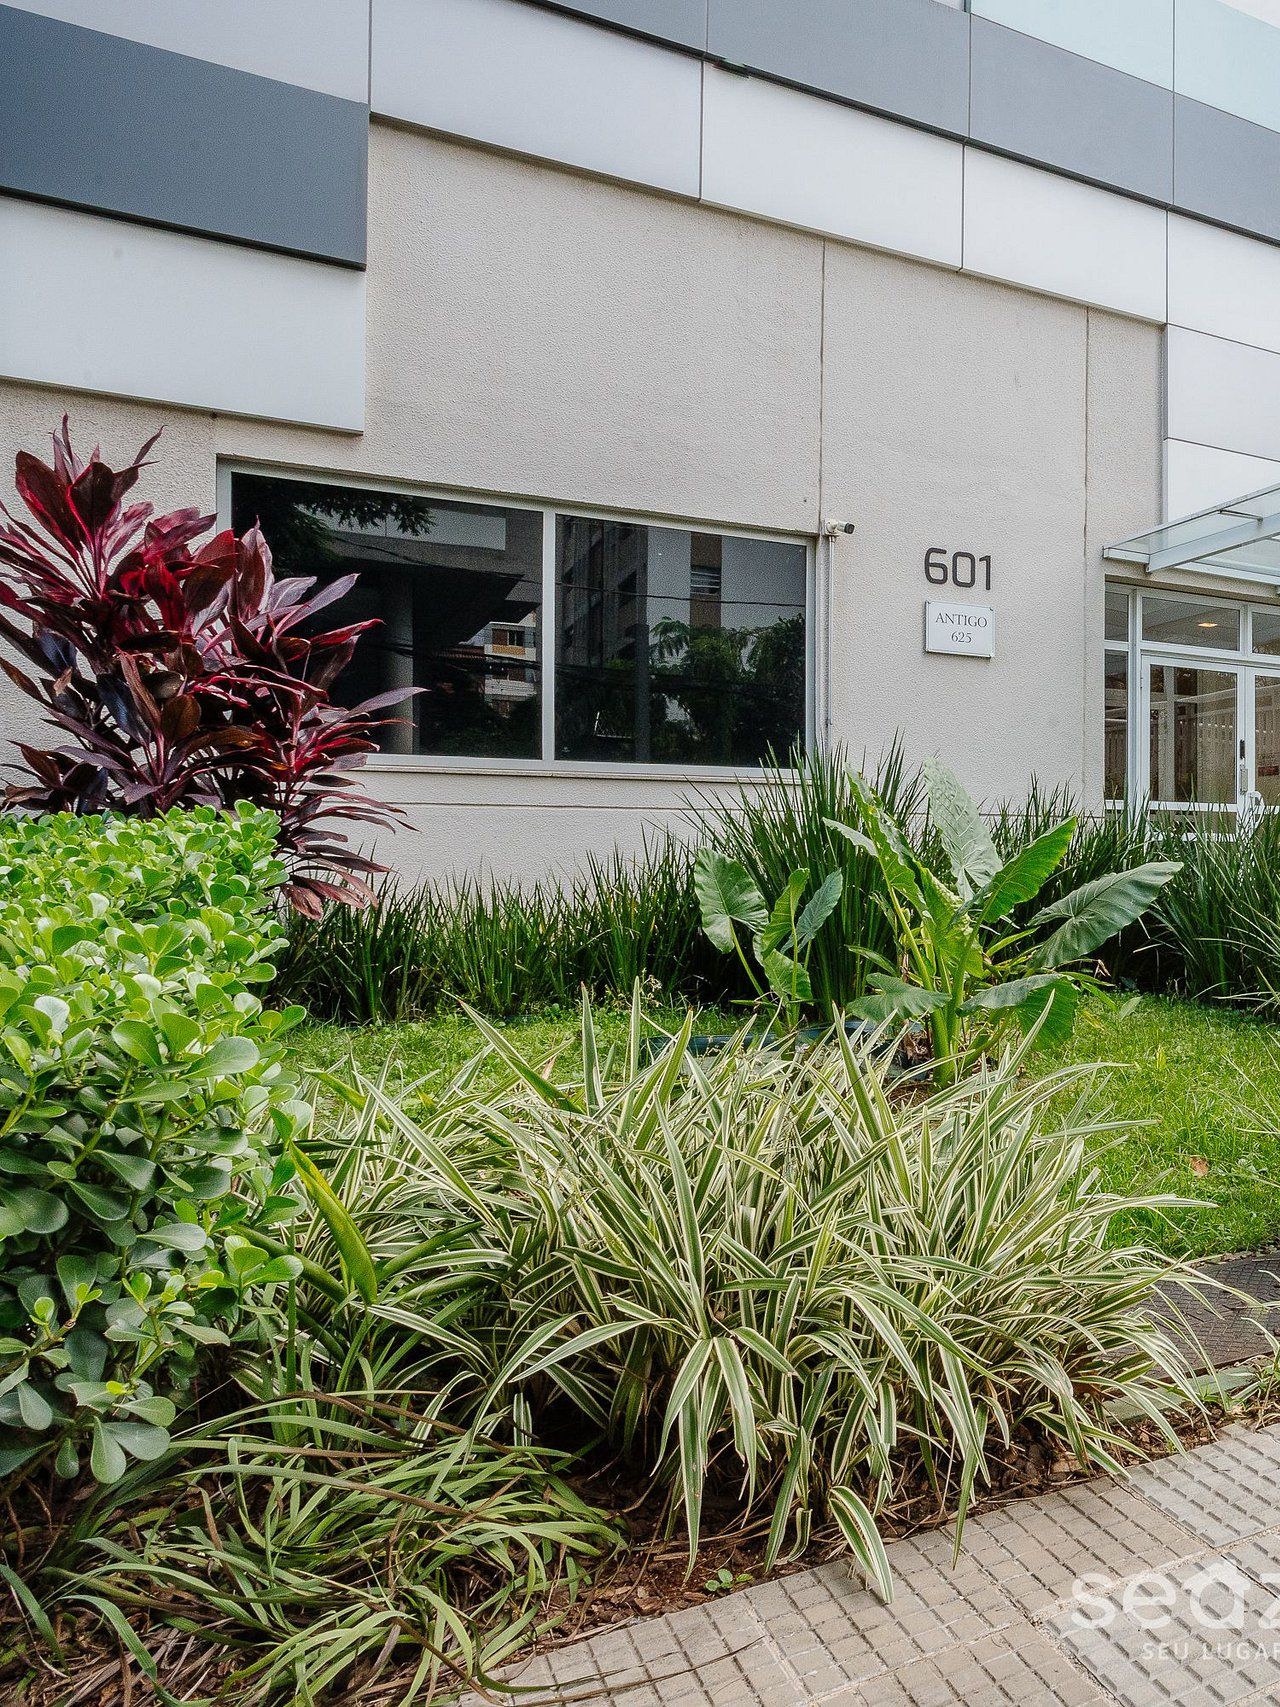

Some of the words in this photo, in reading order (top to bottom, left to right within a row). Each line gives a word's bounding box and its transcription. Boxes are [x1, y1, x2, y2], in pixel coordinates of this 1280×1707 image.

[924, 547, 991, 591] 601
[935, 612, 988, 628] ANTIGO
[951, 631, 972, 644] 625
